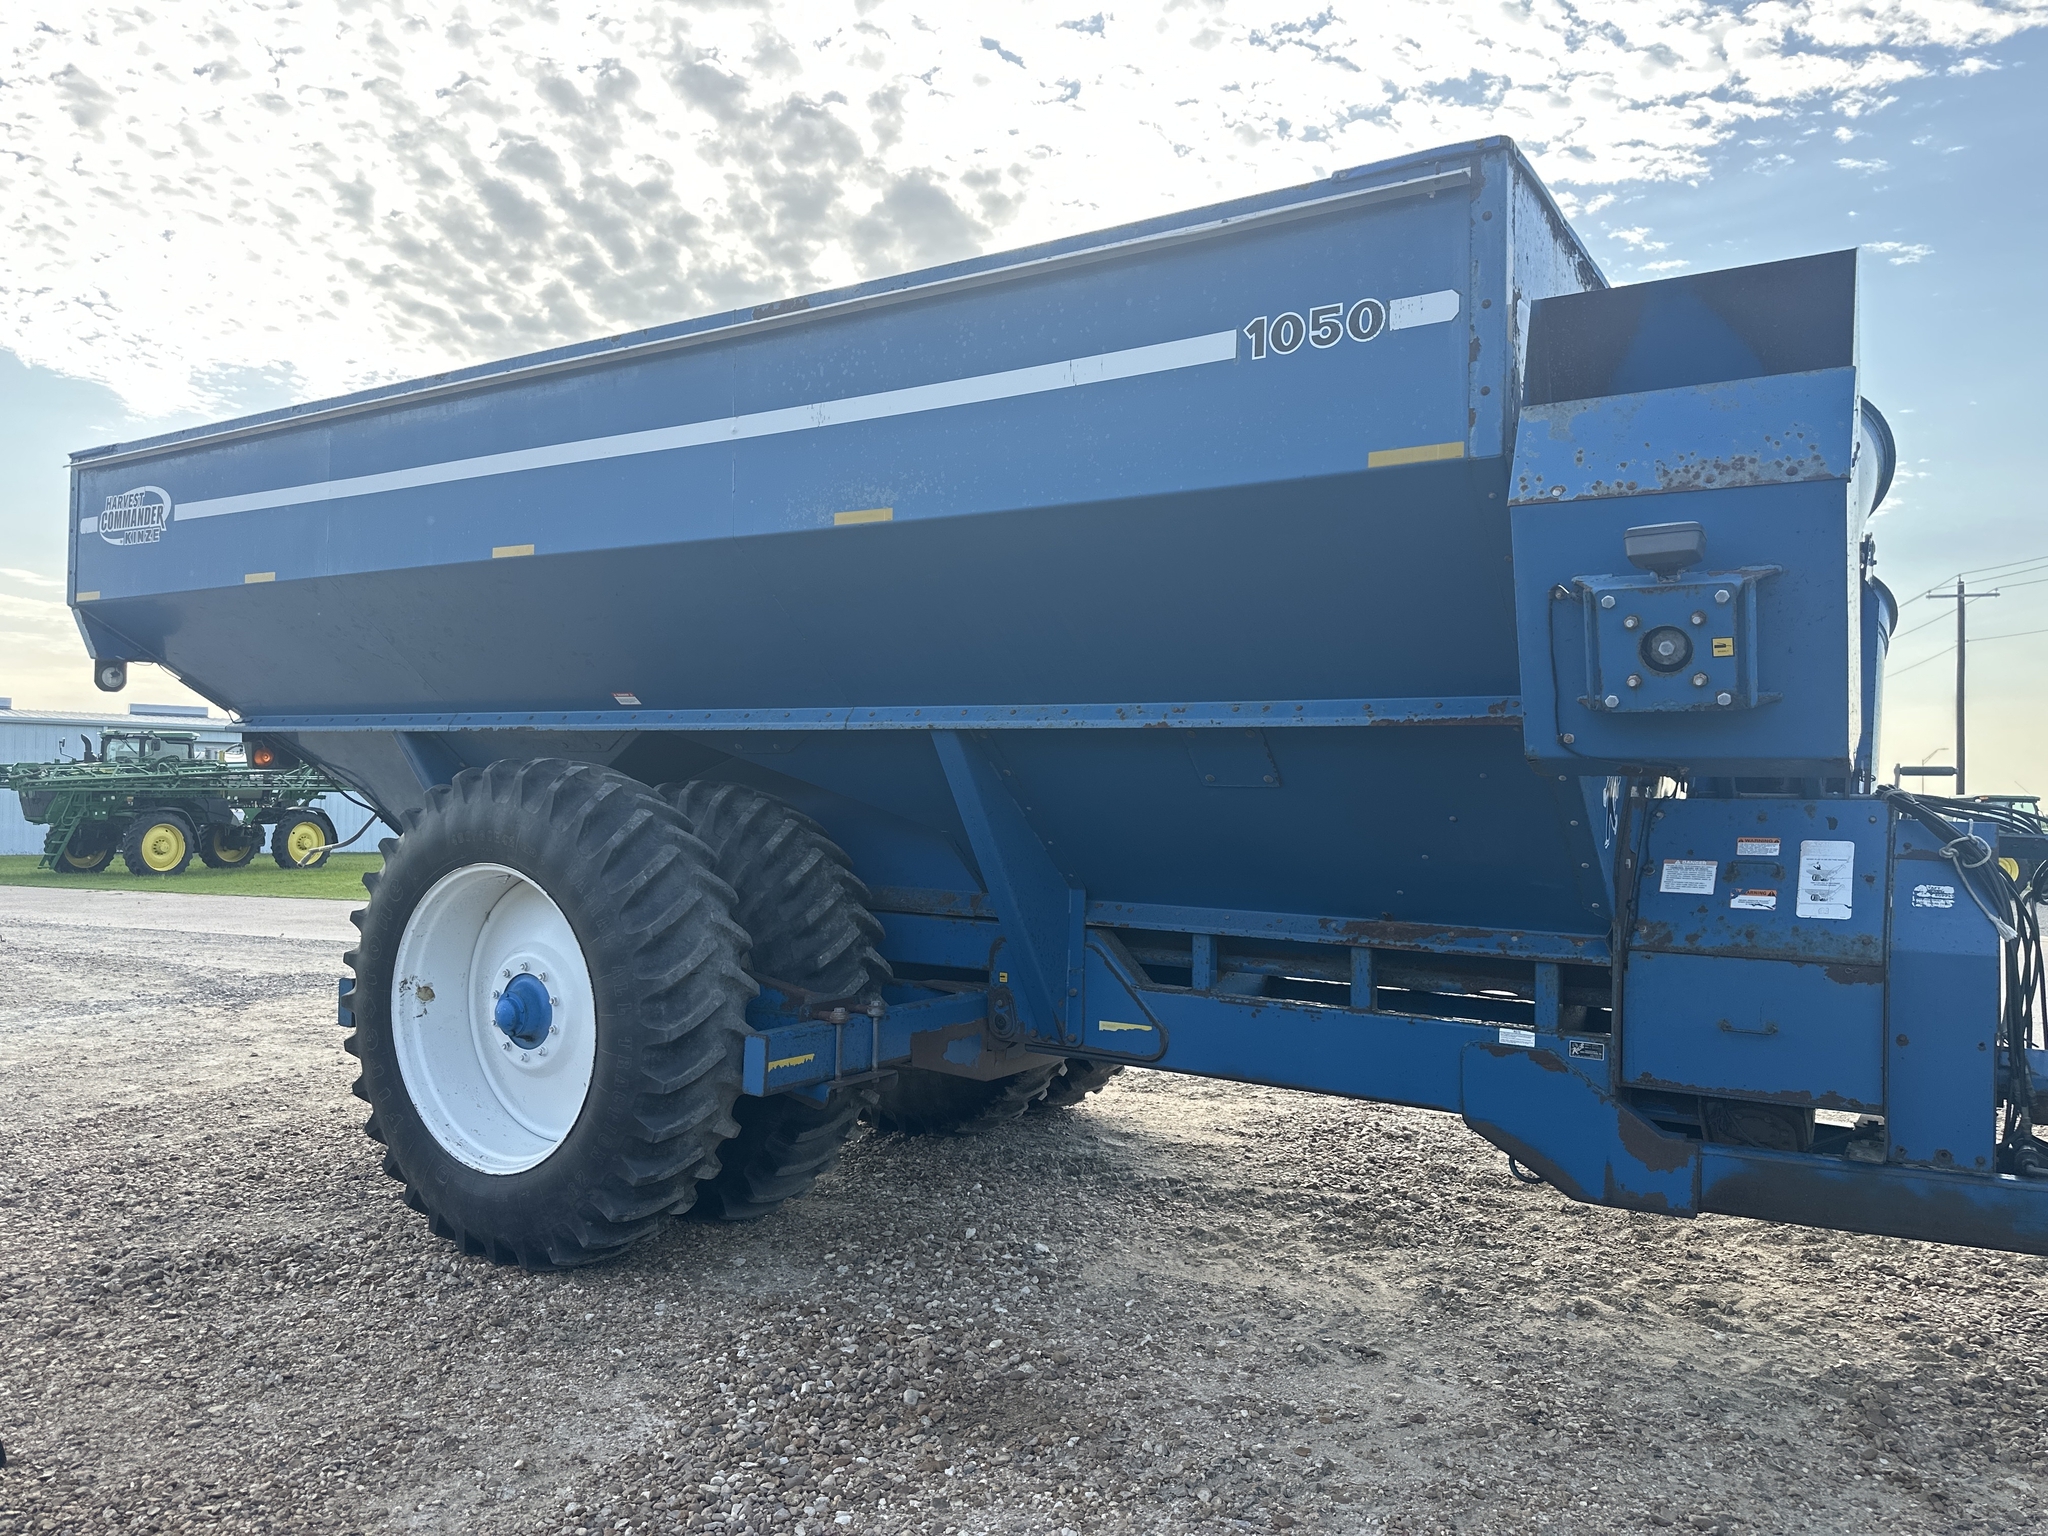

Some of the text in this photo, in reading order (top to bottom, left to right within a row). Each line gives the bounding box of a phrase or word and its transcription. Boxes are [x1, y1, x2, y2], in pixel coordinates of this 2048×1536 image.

[1243, 298, 1386, 360] 1050
[101, 505, 165, 531] COMMANDER
[106, 492, 145, 510] HARVEST
[125, 528, 160, 545] KINZE
[611, 964, 632, 1016] ALL
[590, 1036, 633, 1165] TRACTION
